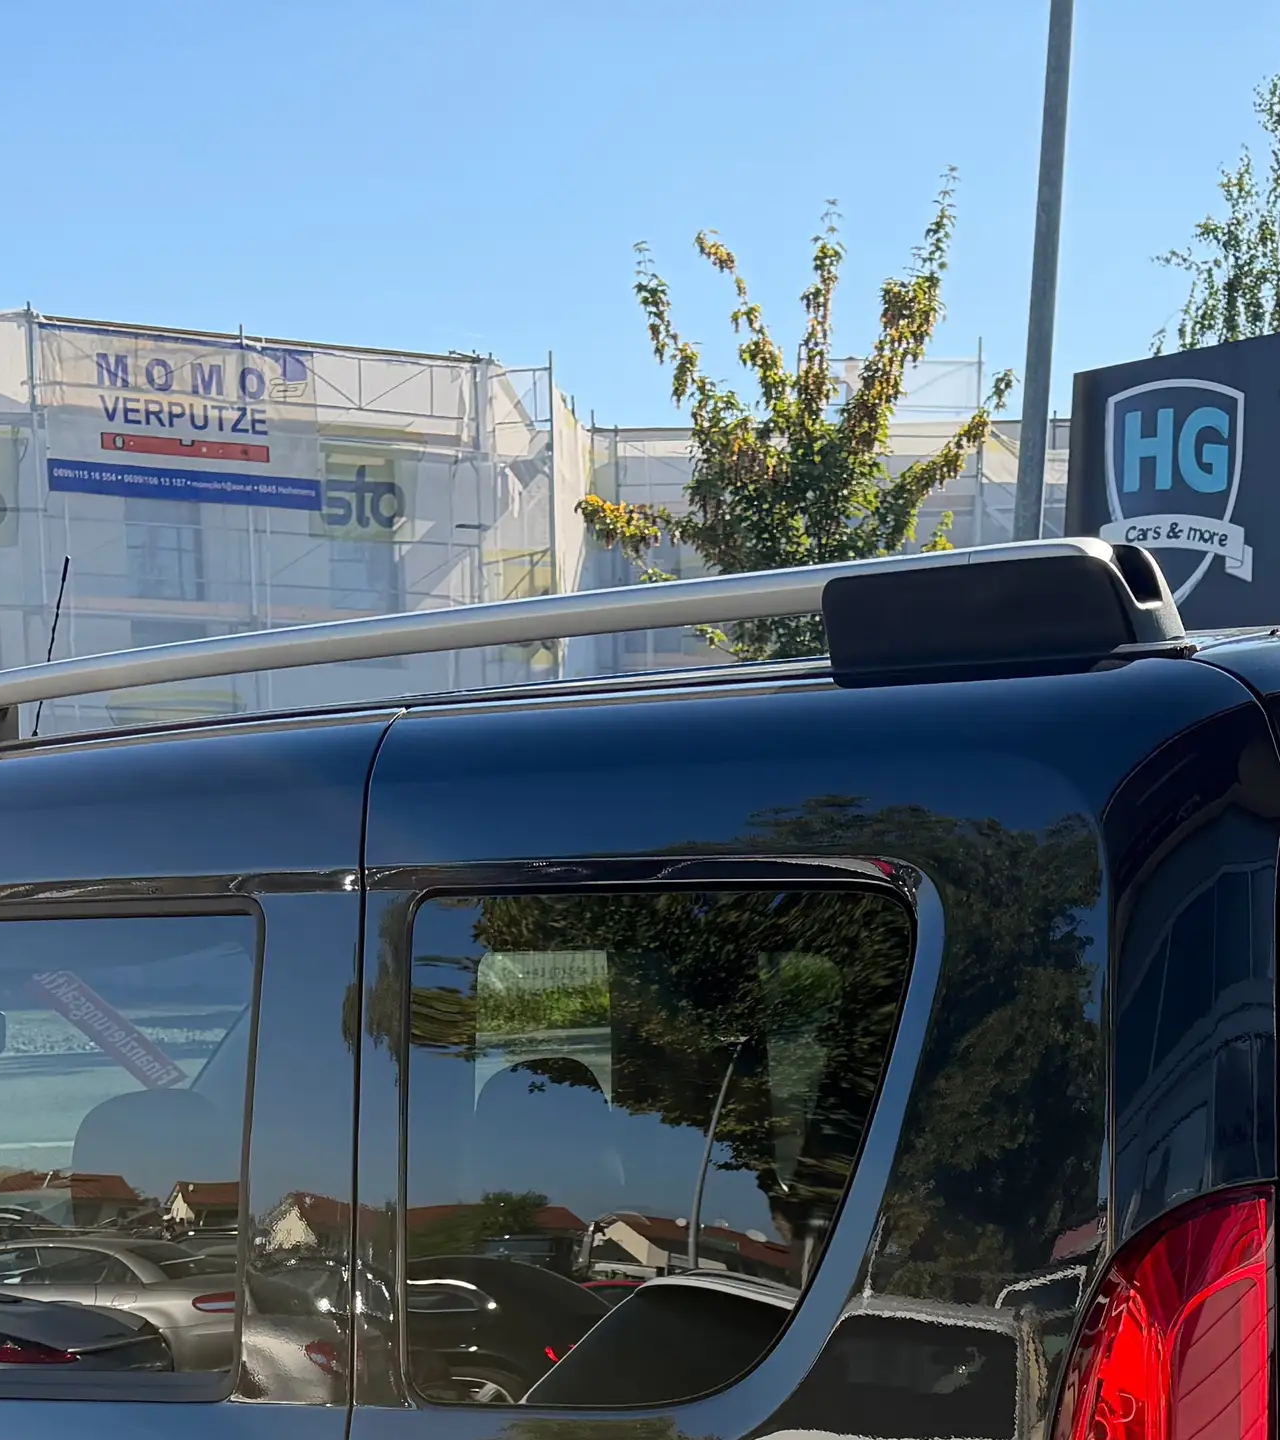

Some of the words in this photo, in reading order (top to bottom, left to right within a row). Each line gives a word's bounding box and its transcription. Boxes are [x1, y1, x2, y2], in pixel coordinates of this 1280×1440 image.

[95, 352, 266, 401] MOMO
[98, 394, 269, 436] VERPUTZE
[1123, 407, 1230, 493] HG
[320, 465, 406, 529] sto
[1124, 525, 1161, 543] Cars
[1166, 522, 1184, 540] &
[1187, 526, 1229, 548] more
